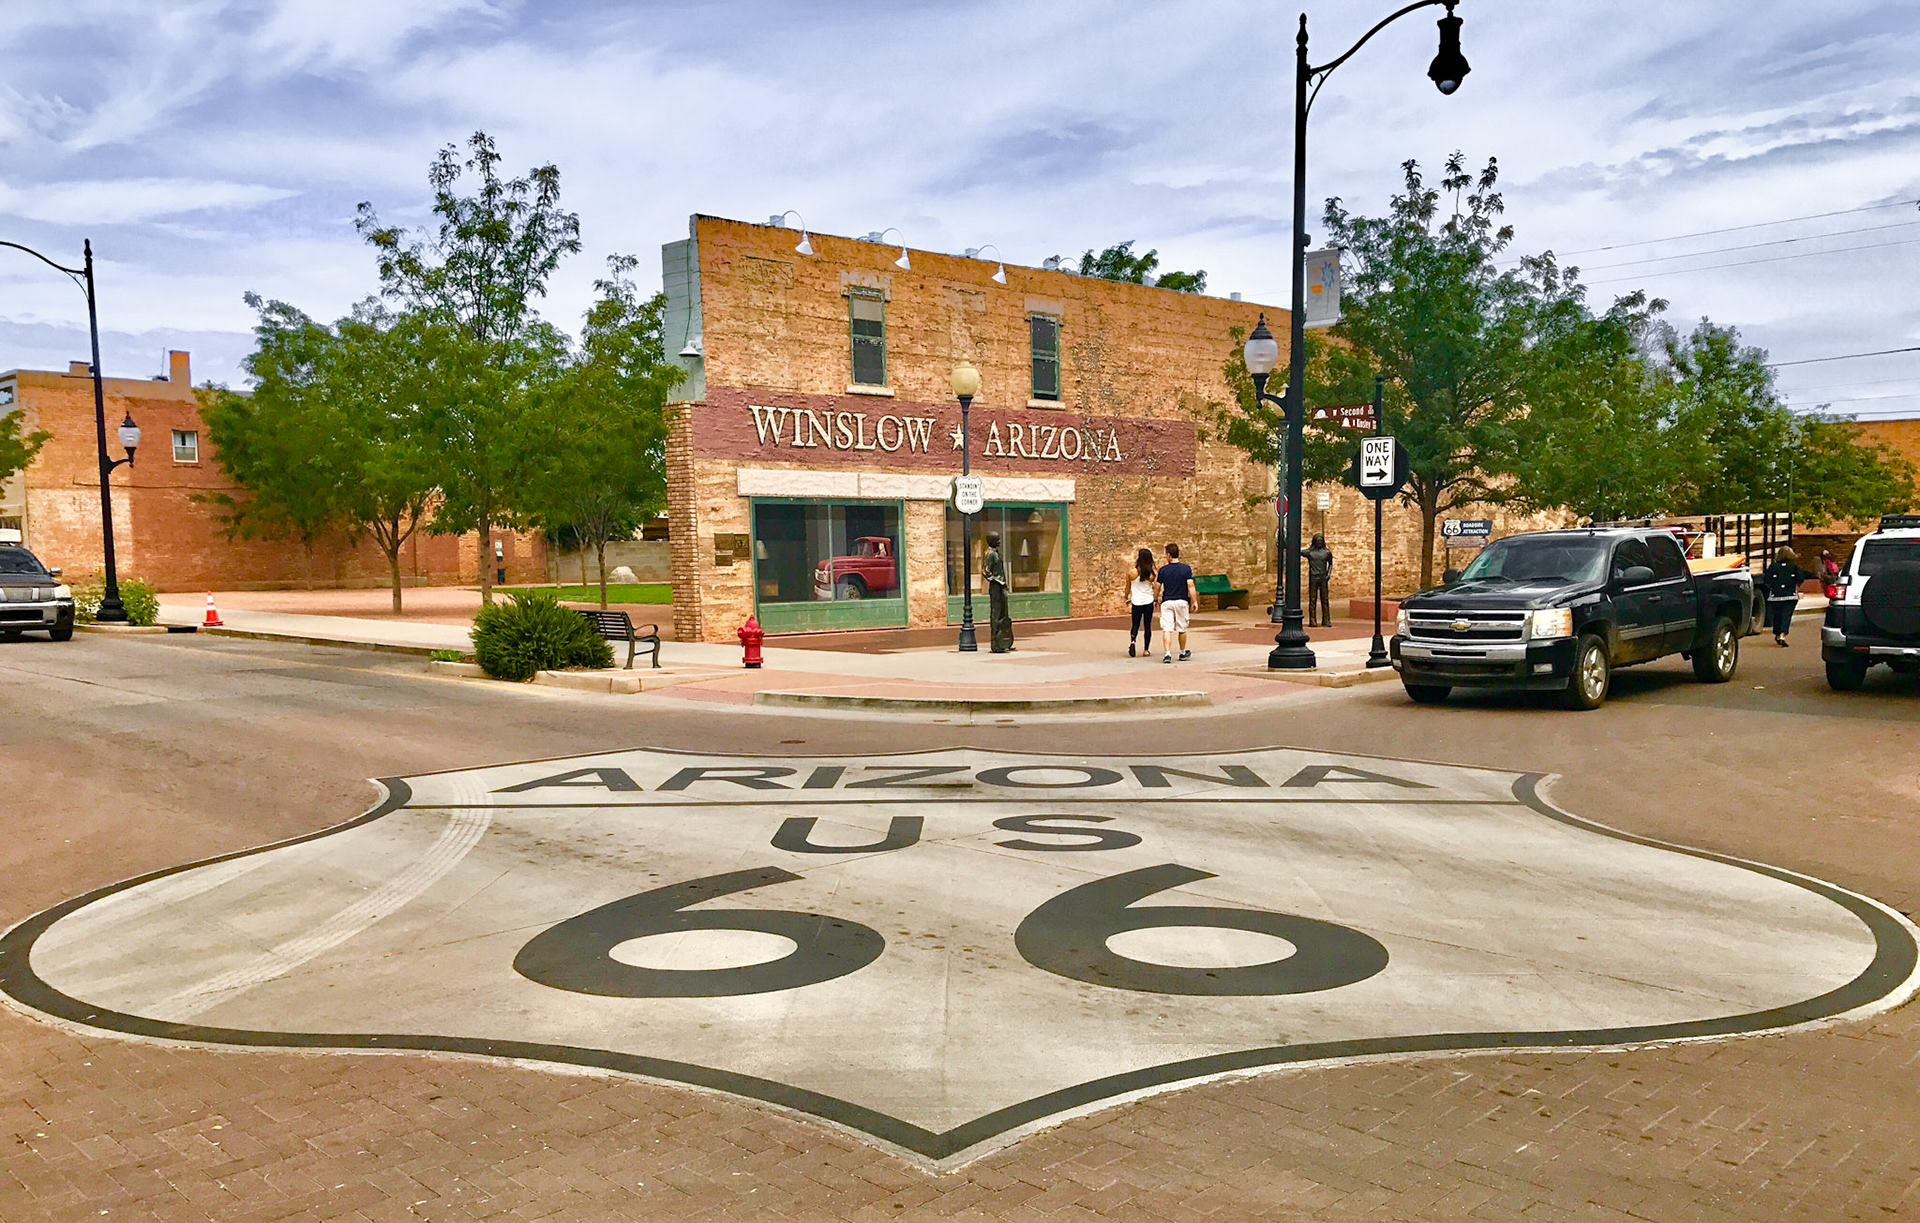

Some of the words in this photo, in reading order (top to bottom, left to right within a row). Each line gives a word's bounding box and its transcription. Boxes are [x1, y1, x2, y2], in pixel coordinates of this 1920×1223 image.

[1340, 406, 1364, 416] Second
[748, 404, 936, 453] WINSLOW
[982, 420, 1122, 462] ARIZONA
[1366, 441, 1389, 454] ONE
[1365, 454, 1390, 467] WAY
[1445, 525, 1459, 535] 66
[488, 765, 1438, 793] ARIZONA
